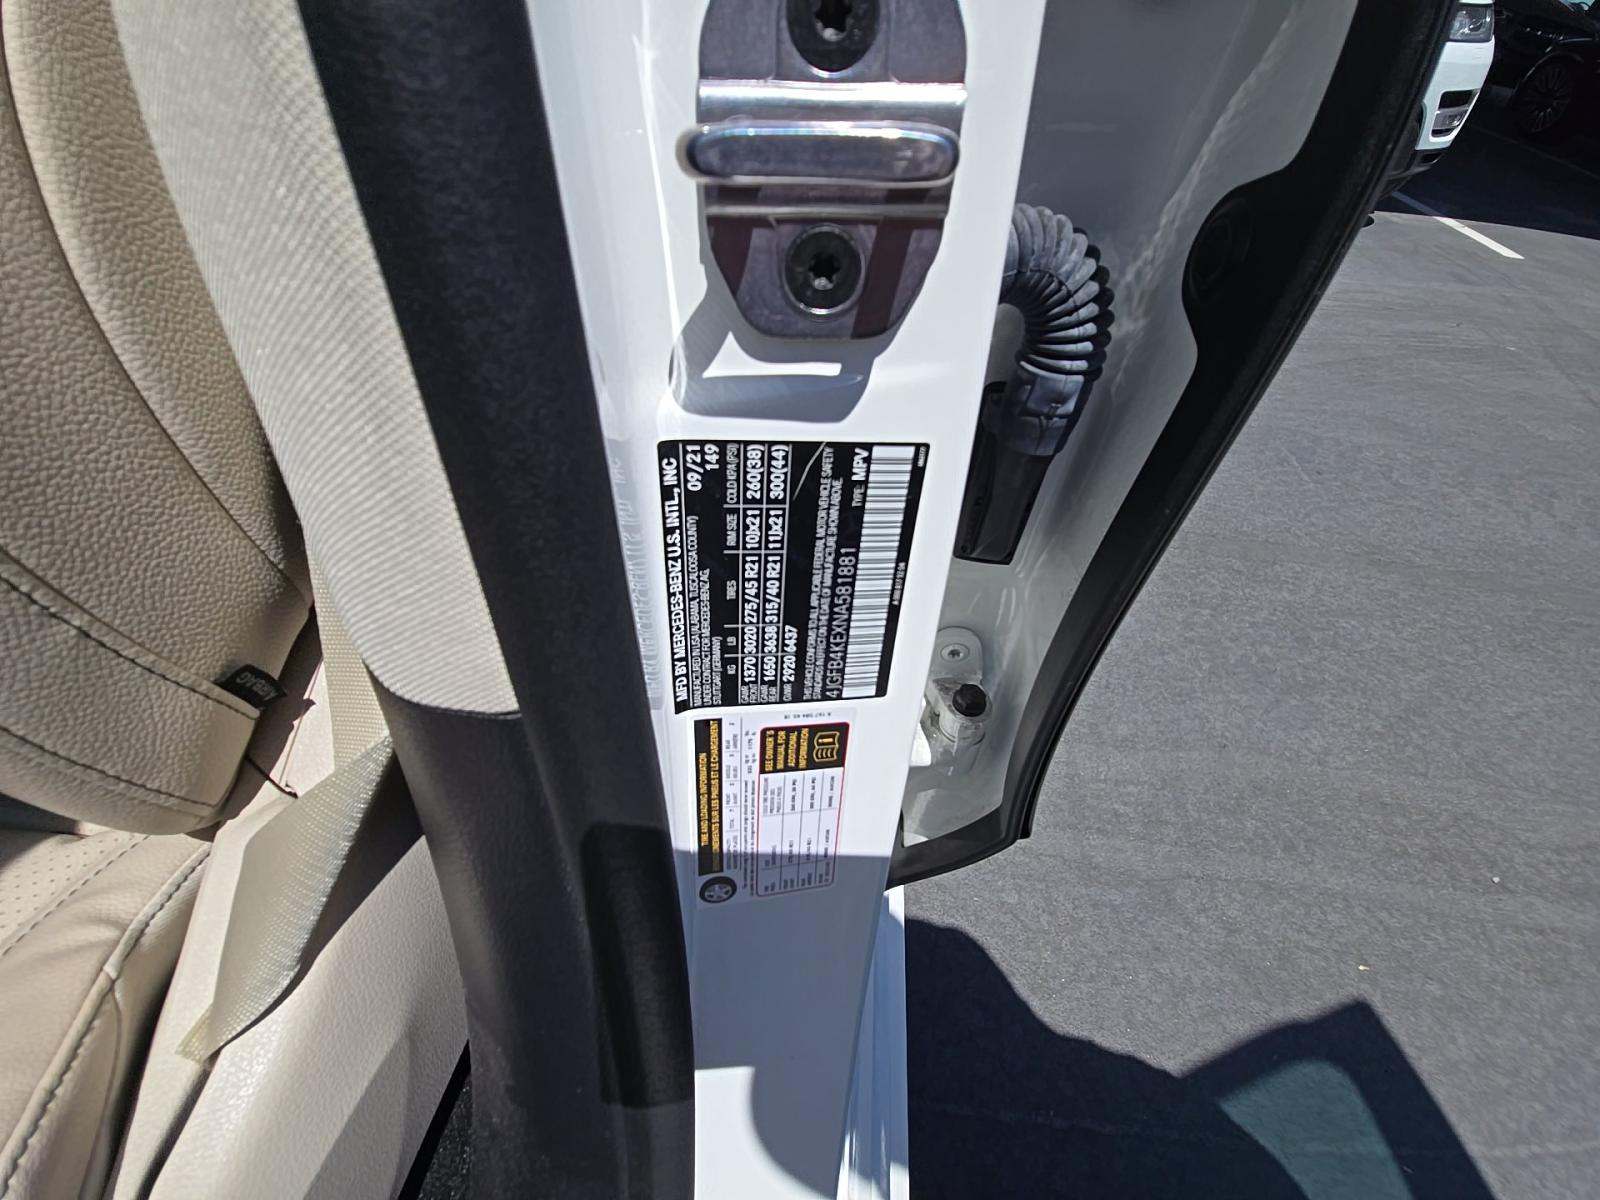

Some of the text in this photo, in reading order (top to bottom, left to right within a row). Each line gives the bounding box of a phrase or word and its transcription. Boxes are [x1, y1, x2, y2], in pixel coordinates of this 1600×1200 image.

[662, 457, 678, 485] INC
[686, 445, 704, 491] 09/21
[704, 443, 719, 470] 149
[821, 446, 834, 477] SAFETY
[818, 478, 831, 509] VEHICLE
[851, 447, 869, 507] TYPE: MPV
[816, 510, 827, 537] MOTOR
[667, 530, 681, 557] U.S.
[727, 443, 739, 674] KG LB TIRES RIM SIZE COLD KPA (PSI)
[688, 551, 698, 598] TUSCALOOSA
[744, 444, 765, 682] 1370 3020 275/45 R21 10Jx21 260(38)
[763, 444, 789, 681] 1650 3638 315/40 R21 11Jx21 300(44)
[668, 559, 685, 659] MERCEDES-BENZ
[700, 582, 710, 636] MERCEDES-BENZ
[825, 548, 857, 697] 4JGFB4KEXNA581881
[691, 634, 700, 648] USA
[702, 638, 710, 651] FOR
[675, 662, 686, 675] BY
[702, 652, 711, 683] CONTRACT
[783, 625, 798, 702] GVWR 2920 6437
[804, 664, 814, 687] VEHICLE
[675, 677, 687, 702] MFD
[692, 657, 702, 706] MANUFACTURED
[703, 684, 711, 706] UNDER
[712, 672, 721, 705] STUTTGART
[749, 684, 757, 703] FRONT
[710, 721, 719, 761] CHARGEMENT
[777, 730, 786, 769] MANUAL FOR
[788, 731, 798, 767] ADDITIONAL
[798, 728, 809, 768] INFORMATION
[699, 752, 707, 793] INFORMATION
[765, 760, 773, 771] SEE
